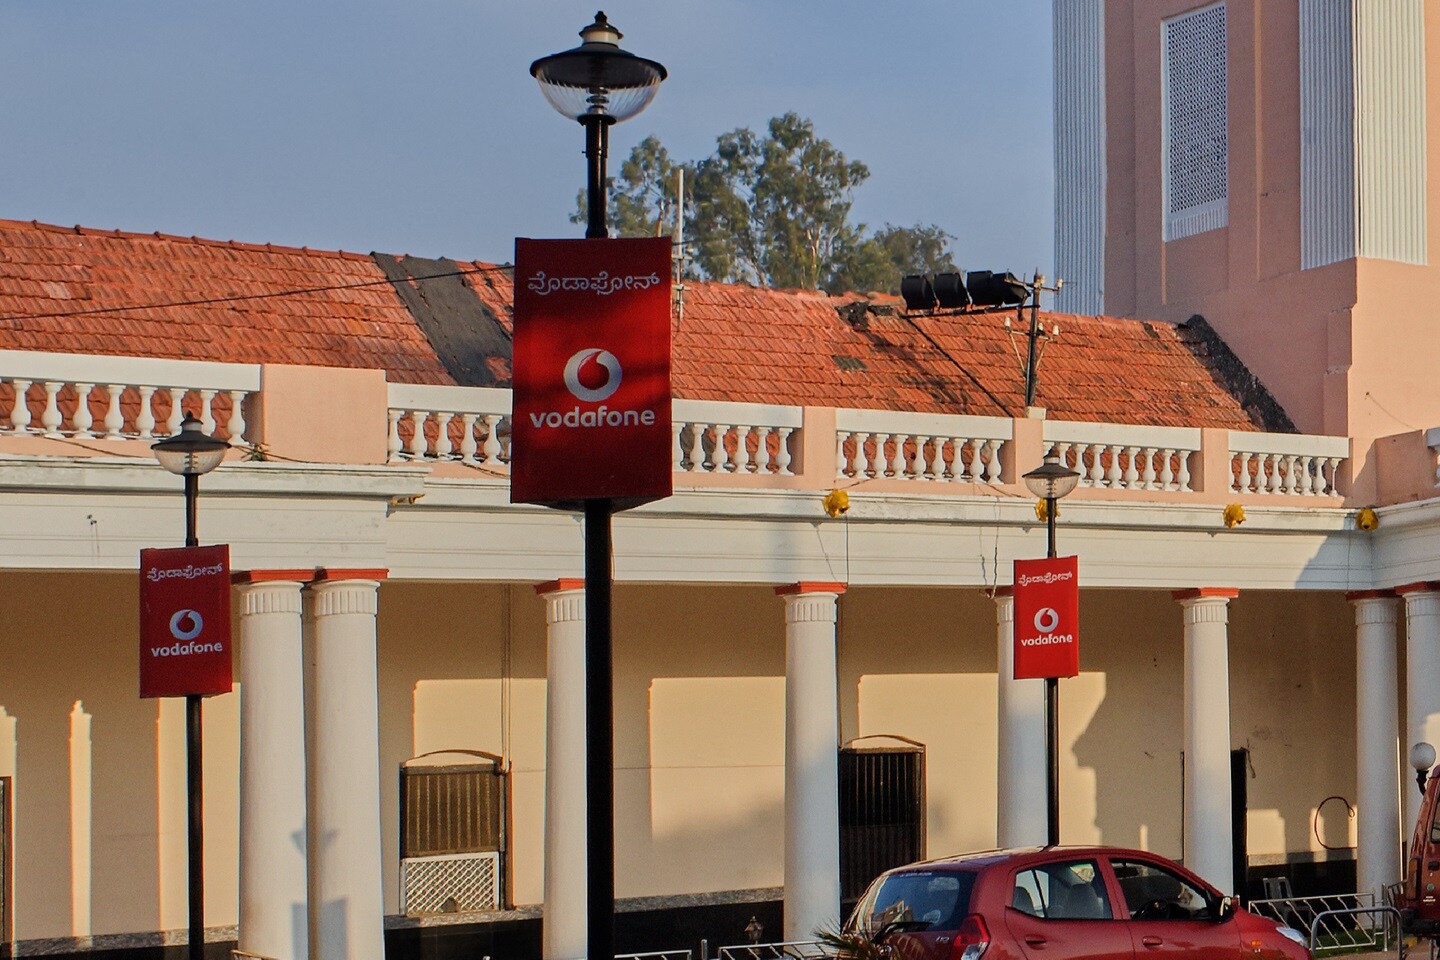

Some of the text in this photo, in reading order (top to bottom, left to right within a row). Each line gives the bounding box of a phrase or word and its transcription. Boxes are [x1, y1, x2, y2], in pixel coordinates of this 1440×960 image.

[529, 405, 656, 428] vodafone
[1021, 633, 1073, 647] vodafone
[151, 641, 223, 657] vodafone
